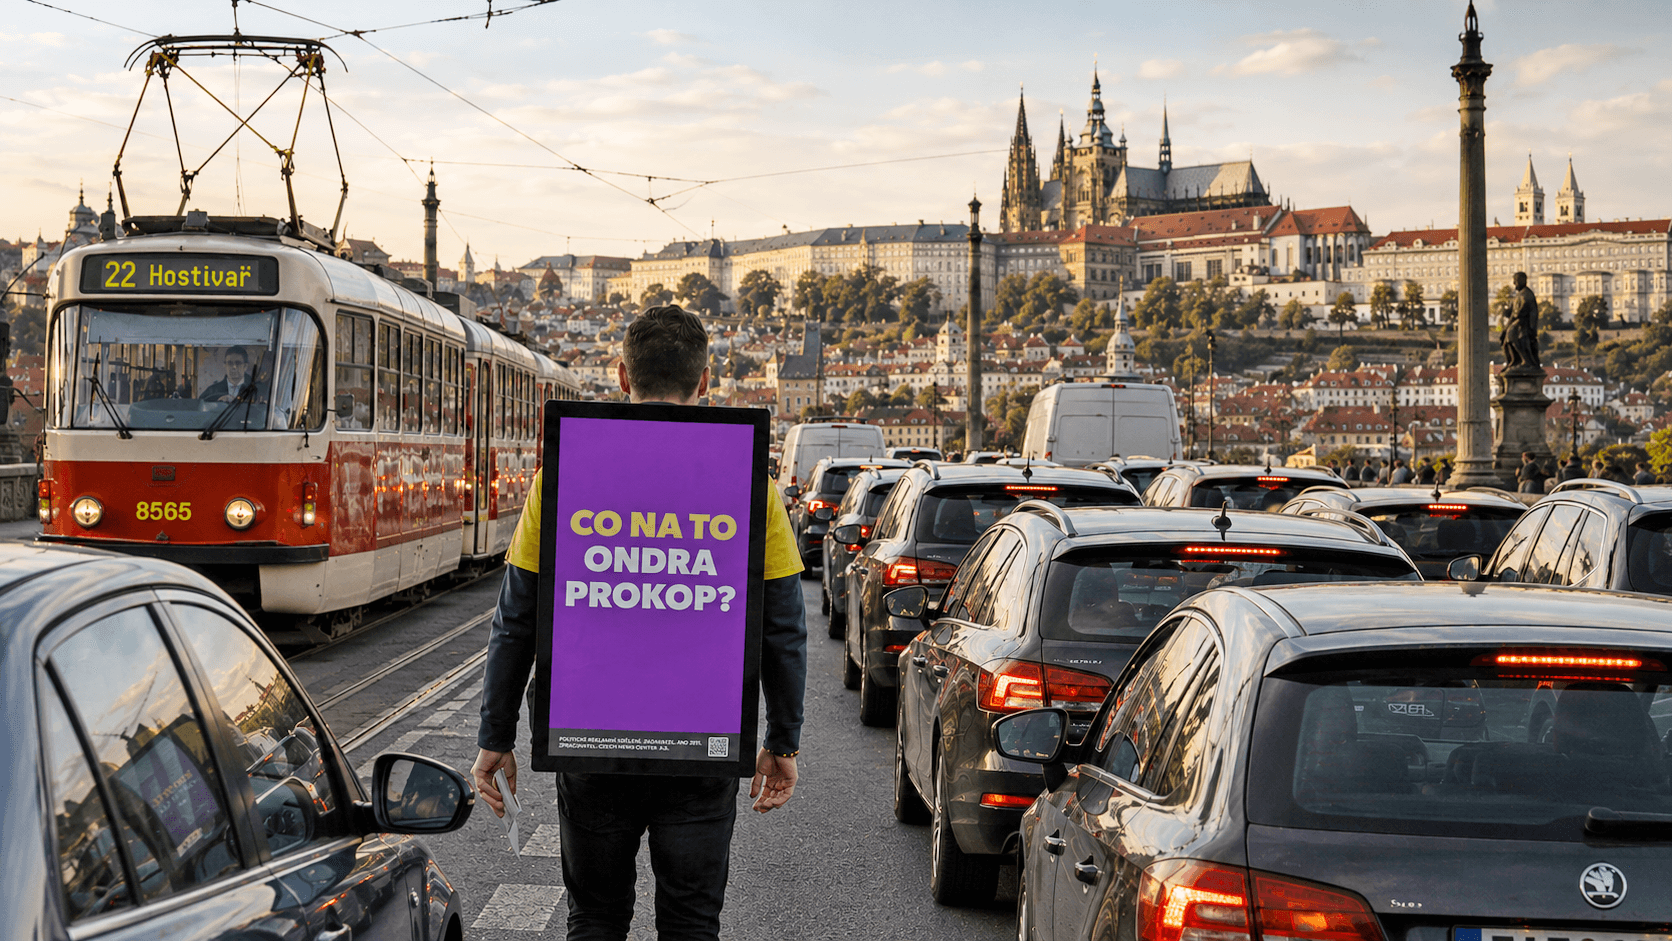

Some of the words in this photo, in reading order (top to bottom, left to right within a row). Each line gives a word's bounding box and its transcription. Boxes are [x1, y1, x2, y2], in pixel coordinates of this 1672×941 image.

[105, 261, 136, 287] 22
[136, 501, 192, 520] 8565
[570, 509, 622, 536] CO
[630, 512, 683, 538] NA
[689, 514, 737, 540] TO
[584, 546, 717, 576] ONDRA
[565, 581, 736, 612] PROKOP?
